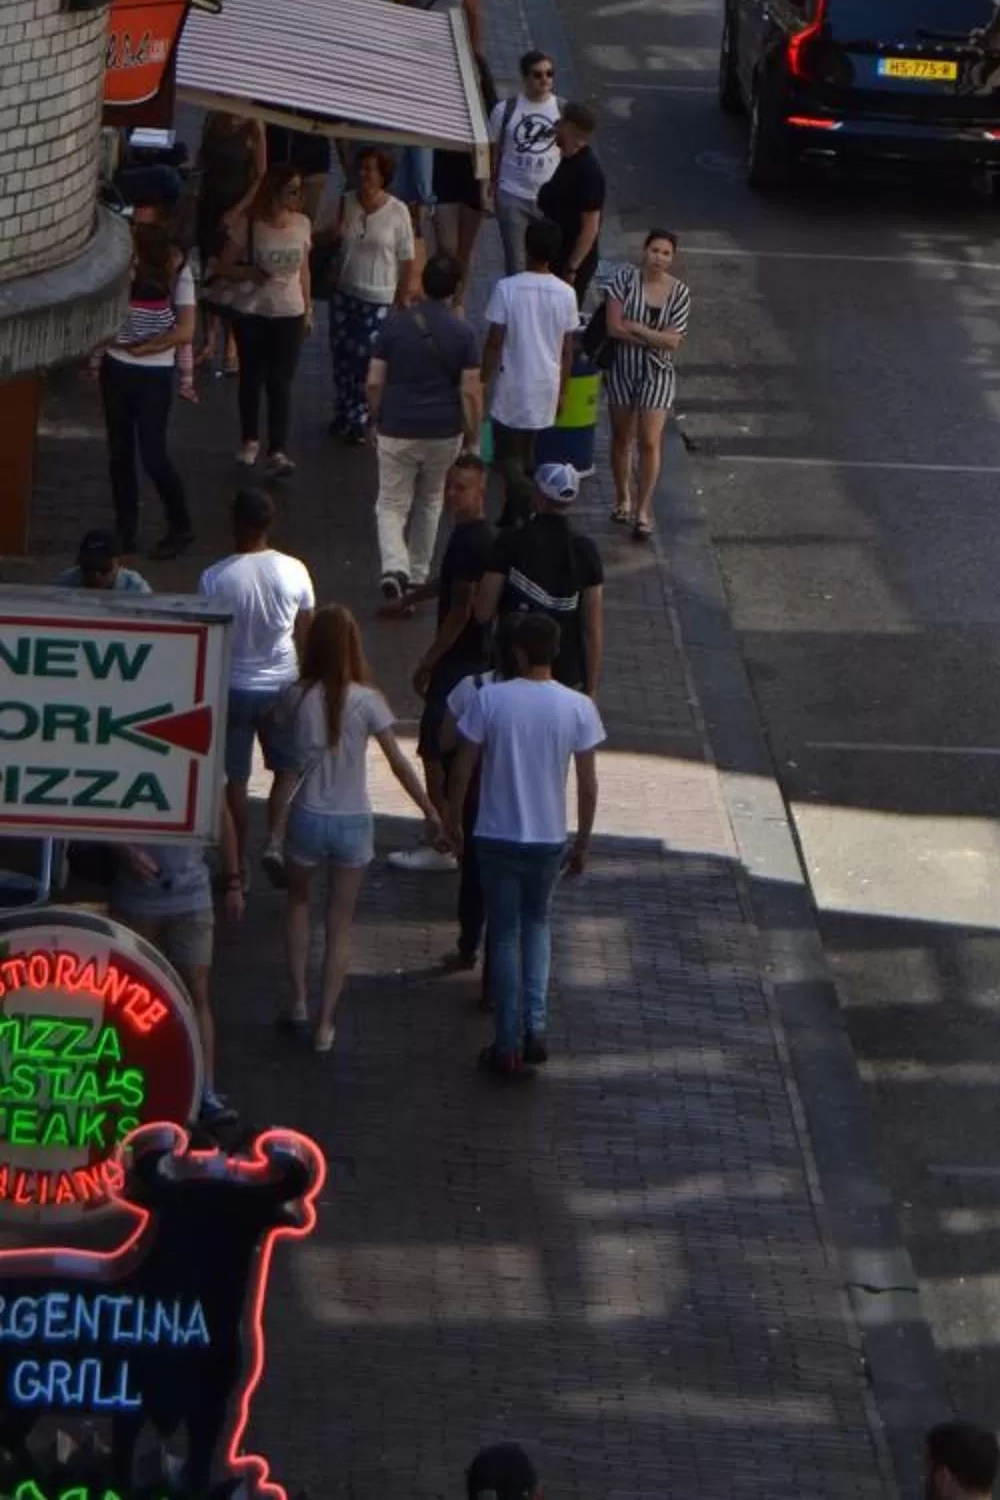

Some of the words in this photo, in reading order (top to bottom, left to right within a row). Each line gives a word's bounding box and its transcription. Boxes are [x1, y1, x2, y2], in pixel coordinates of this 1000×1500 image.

[0, 637, 152, 681] NEW
[0, 765, 171, 811] IZZA
[0, 952, 168, 1033] TORANTE
[0, 1109, 140, 1152] EAKS
[0, 1293, 210, 1345] GENTINA
[14, 1358, 142, 1406] GRILL
